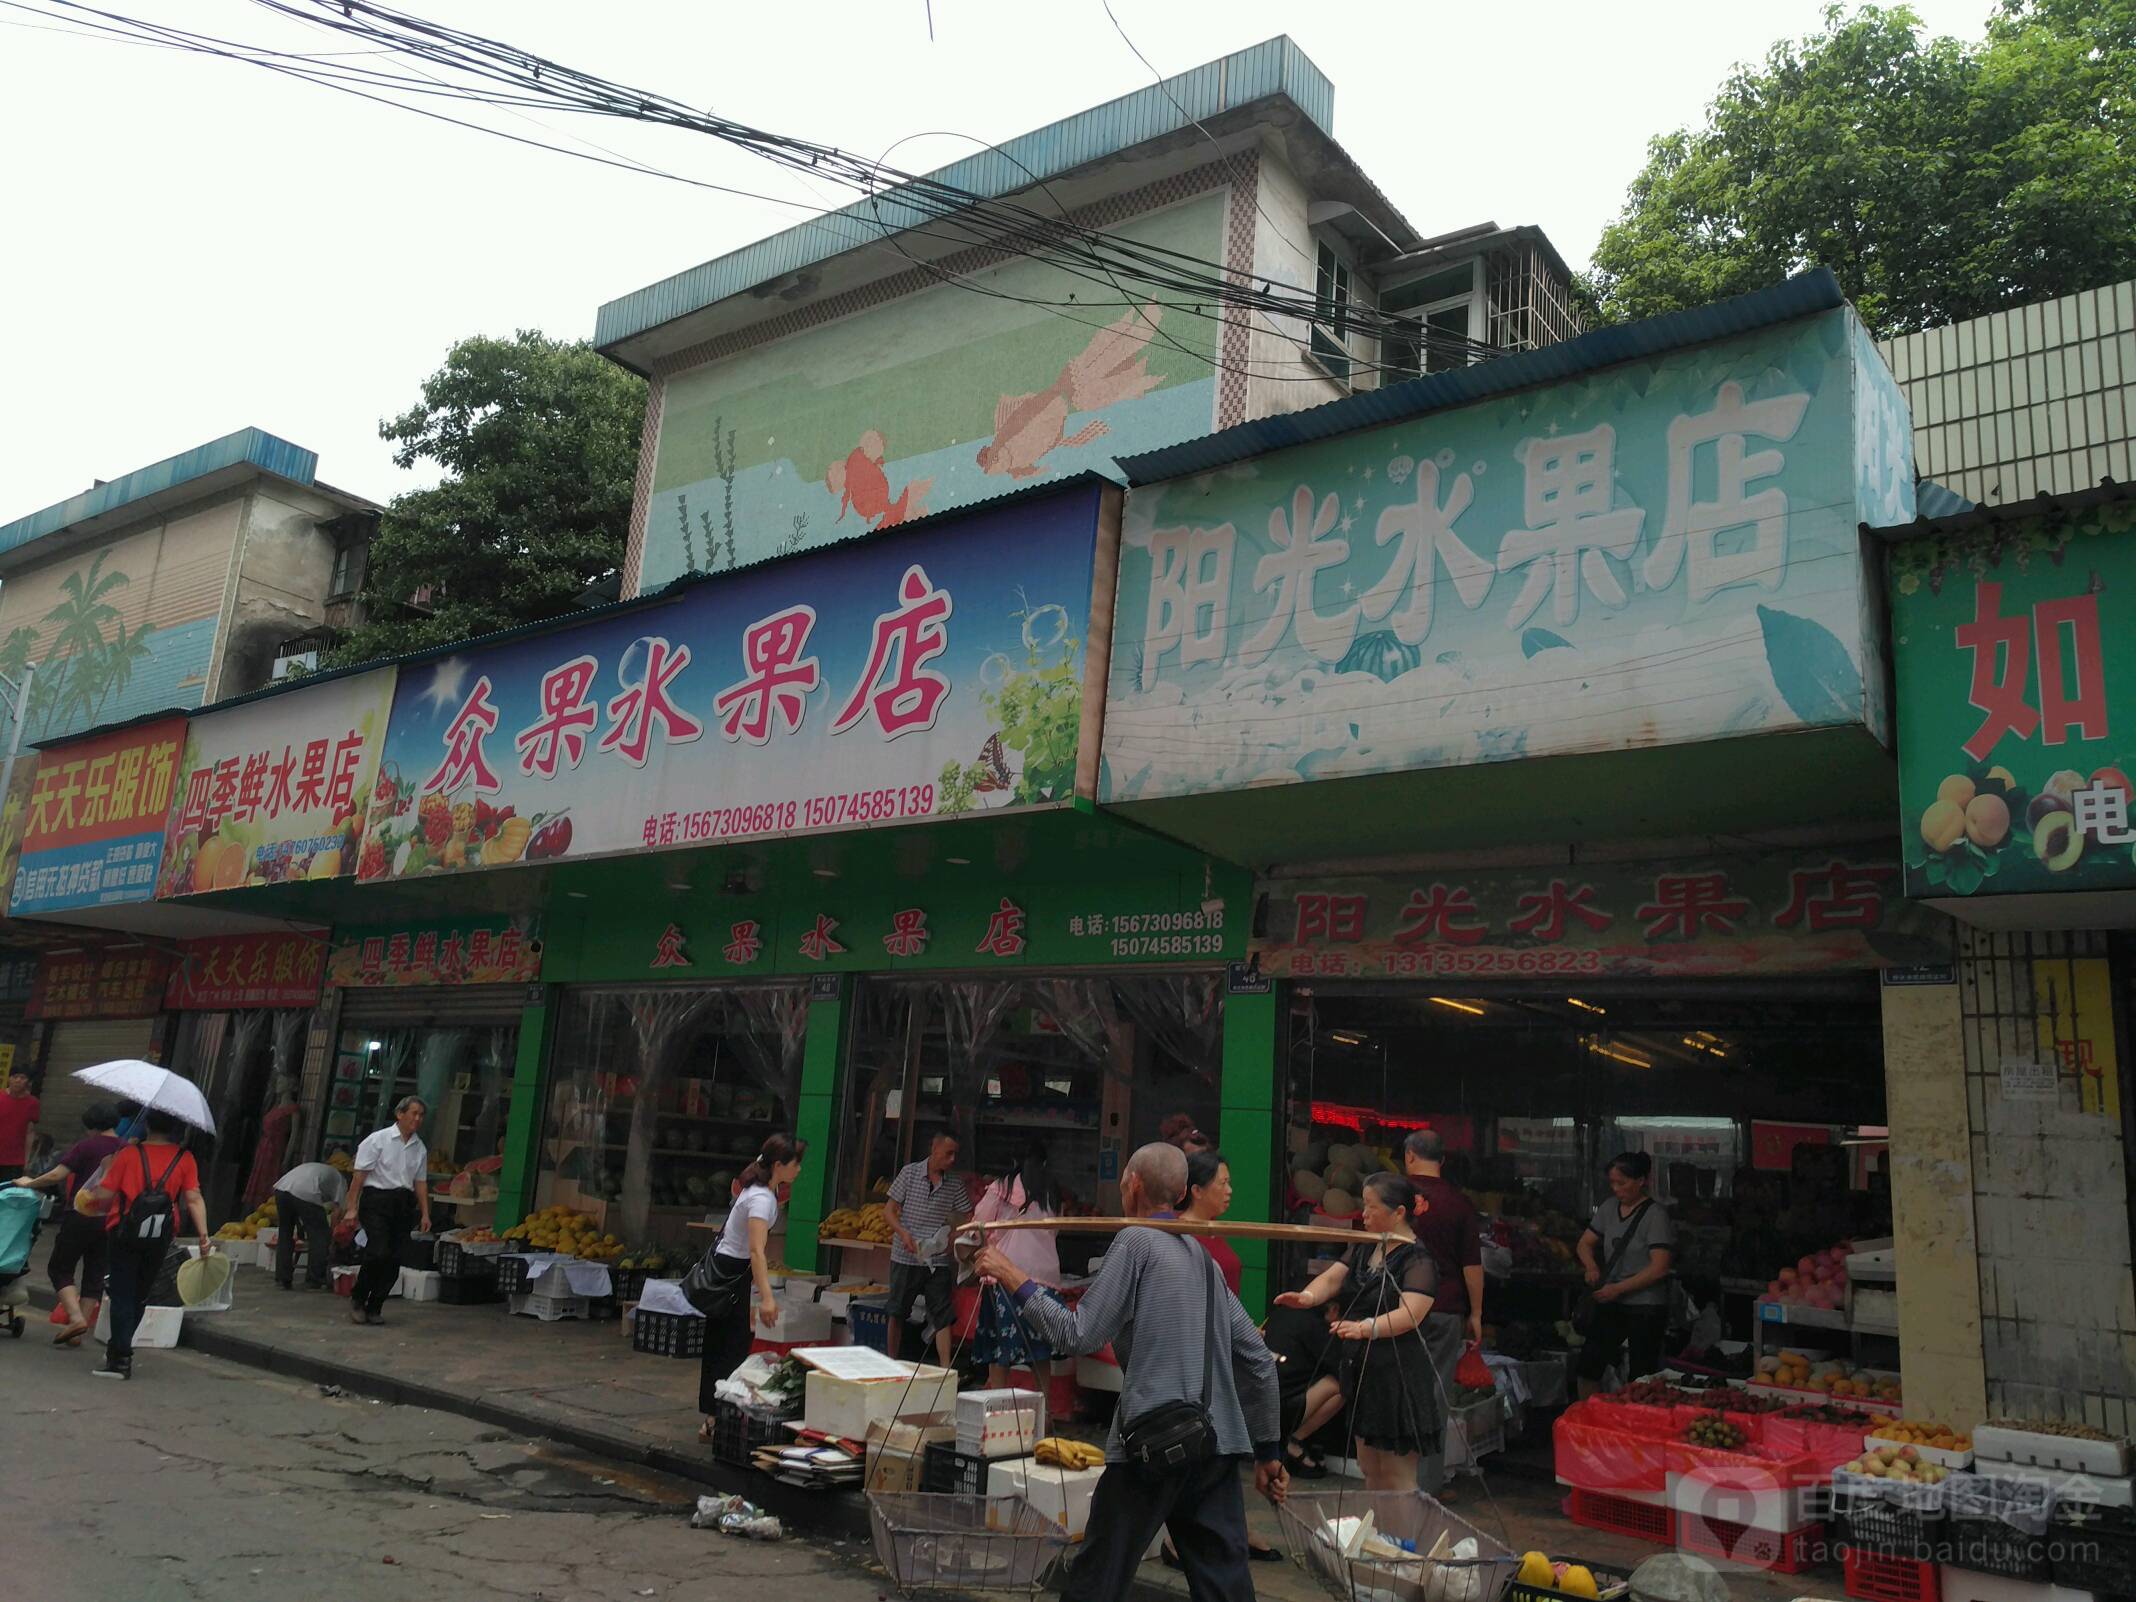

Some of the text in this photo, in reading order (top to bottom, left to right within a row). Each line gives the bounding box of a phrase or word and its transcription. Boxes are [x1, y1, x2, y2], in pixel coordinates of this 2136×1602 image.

[1140, 381, 1810, 693] 阳光水果店
[423, 566, 953, 796] 众果水果店
[1955, 582, 2108, 762] 如
[29, 741, 177, 836] 天天乐服饰
[182, 729, 365, 832] 四季鲜水果店
[642, 783, 934, 847] 电话:15673096818 15074585139
[2072, 779, 2136, 844] 电
[649, 896, 1027, 970] 众果水果店
[1069, 912, 1223, 937] 电话:15673096818
[1296, 862, 1897, 947] 阳光水果店
[200, 941, 321, 988] 天天乐服饰
[361, 928, 521, 972] 四季鲜水果店
[1111, 934, 1223, 957] 15074585139
